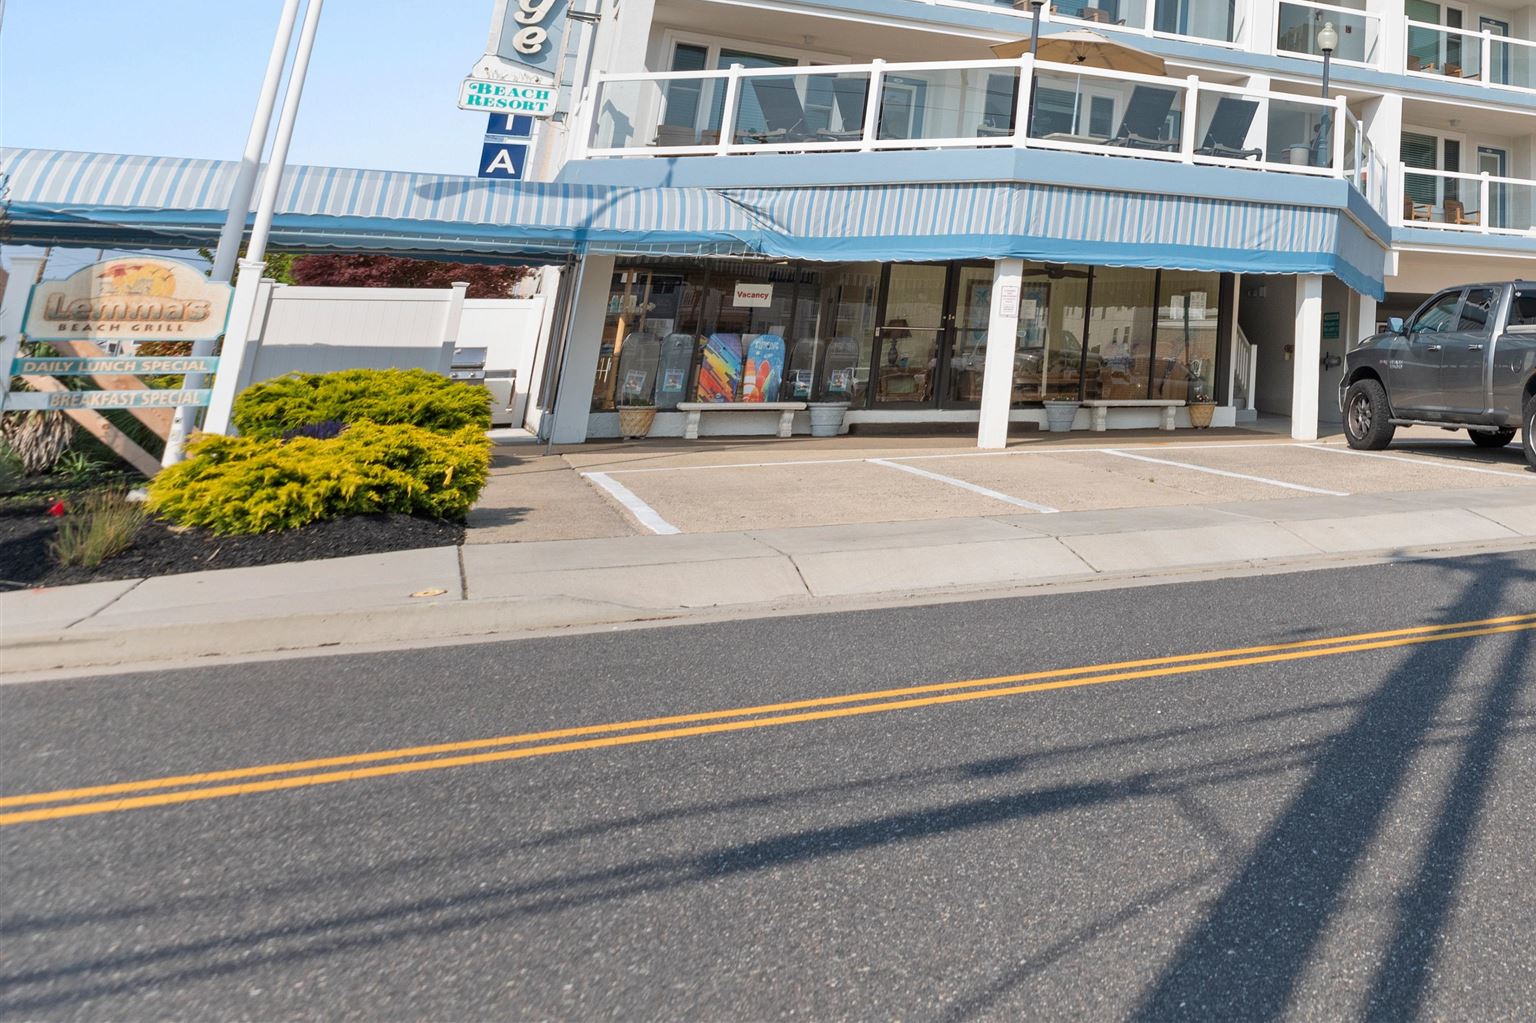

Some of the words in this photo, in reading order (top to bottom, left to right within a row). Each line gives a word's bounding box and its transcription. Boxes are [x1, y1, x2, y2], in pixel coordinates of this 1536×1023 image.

[469, 82, 549, 100] BEACH
[466, 94, 548, 111] RESORT
[737, 291, 769, 300] Vacancy
[44, 292, 211, 322] Lemma's
[58, 323, 120, 332] BEACH
[131, 323, 184, 332] GRILL
[23, 361, 74, 372] DAILY
[78, 361, 135, 372] LUNCH
[141, 361, 208, 372] SPECIAL
[50, 391, 136, 407] BREAKFAST
[141, 391, 201, 406] SPECIAL
